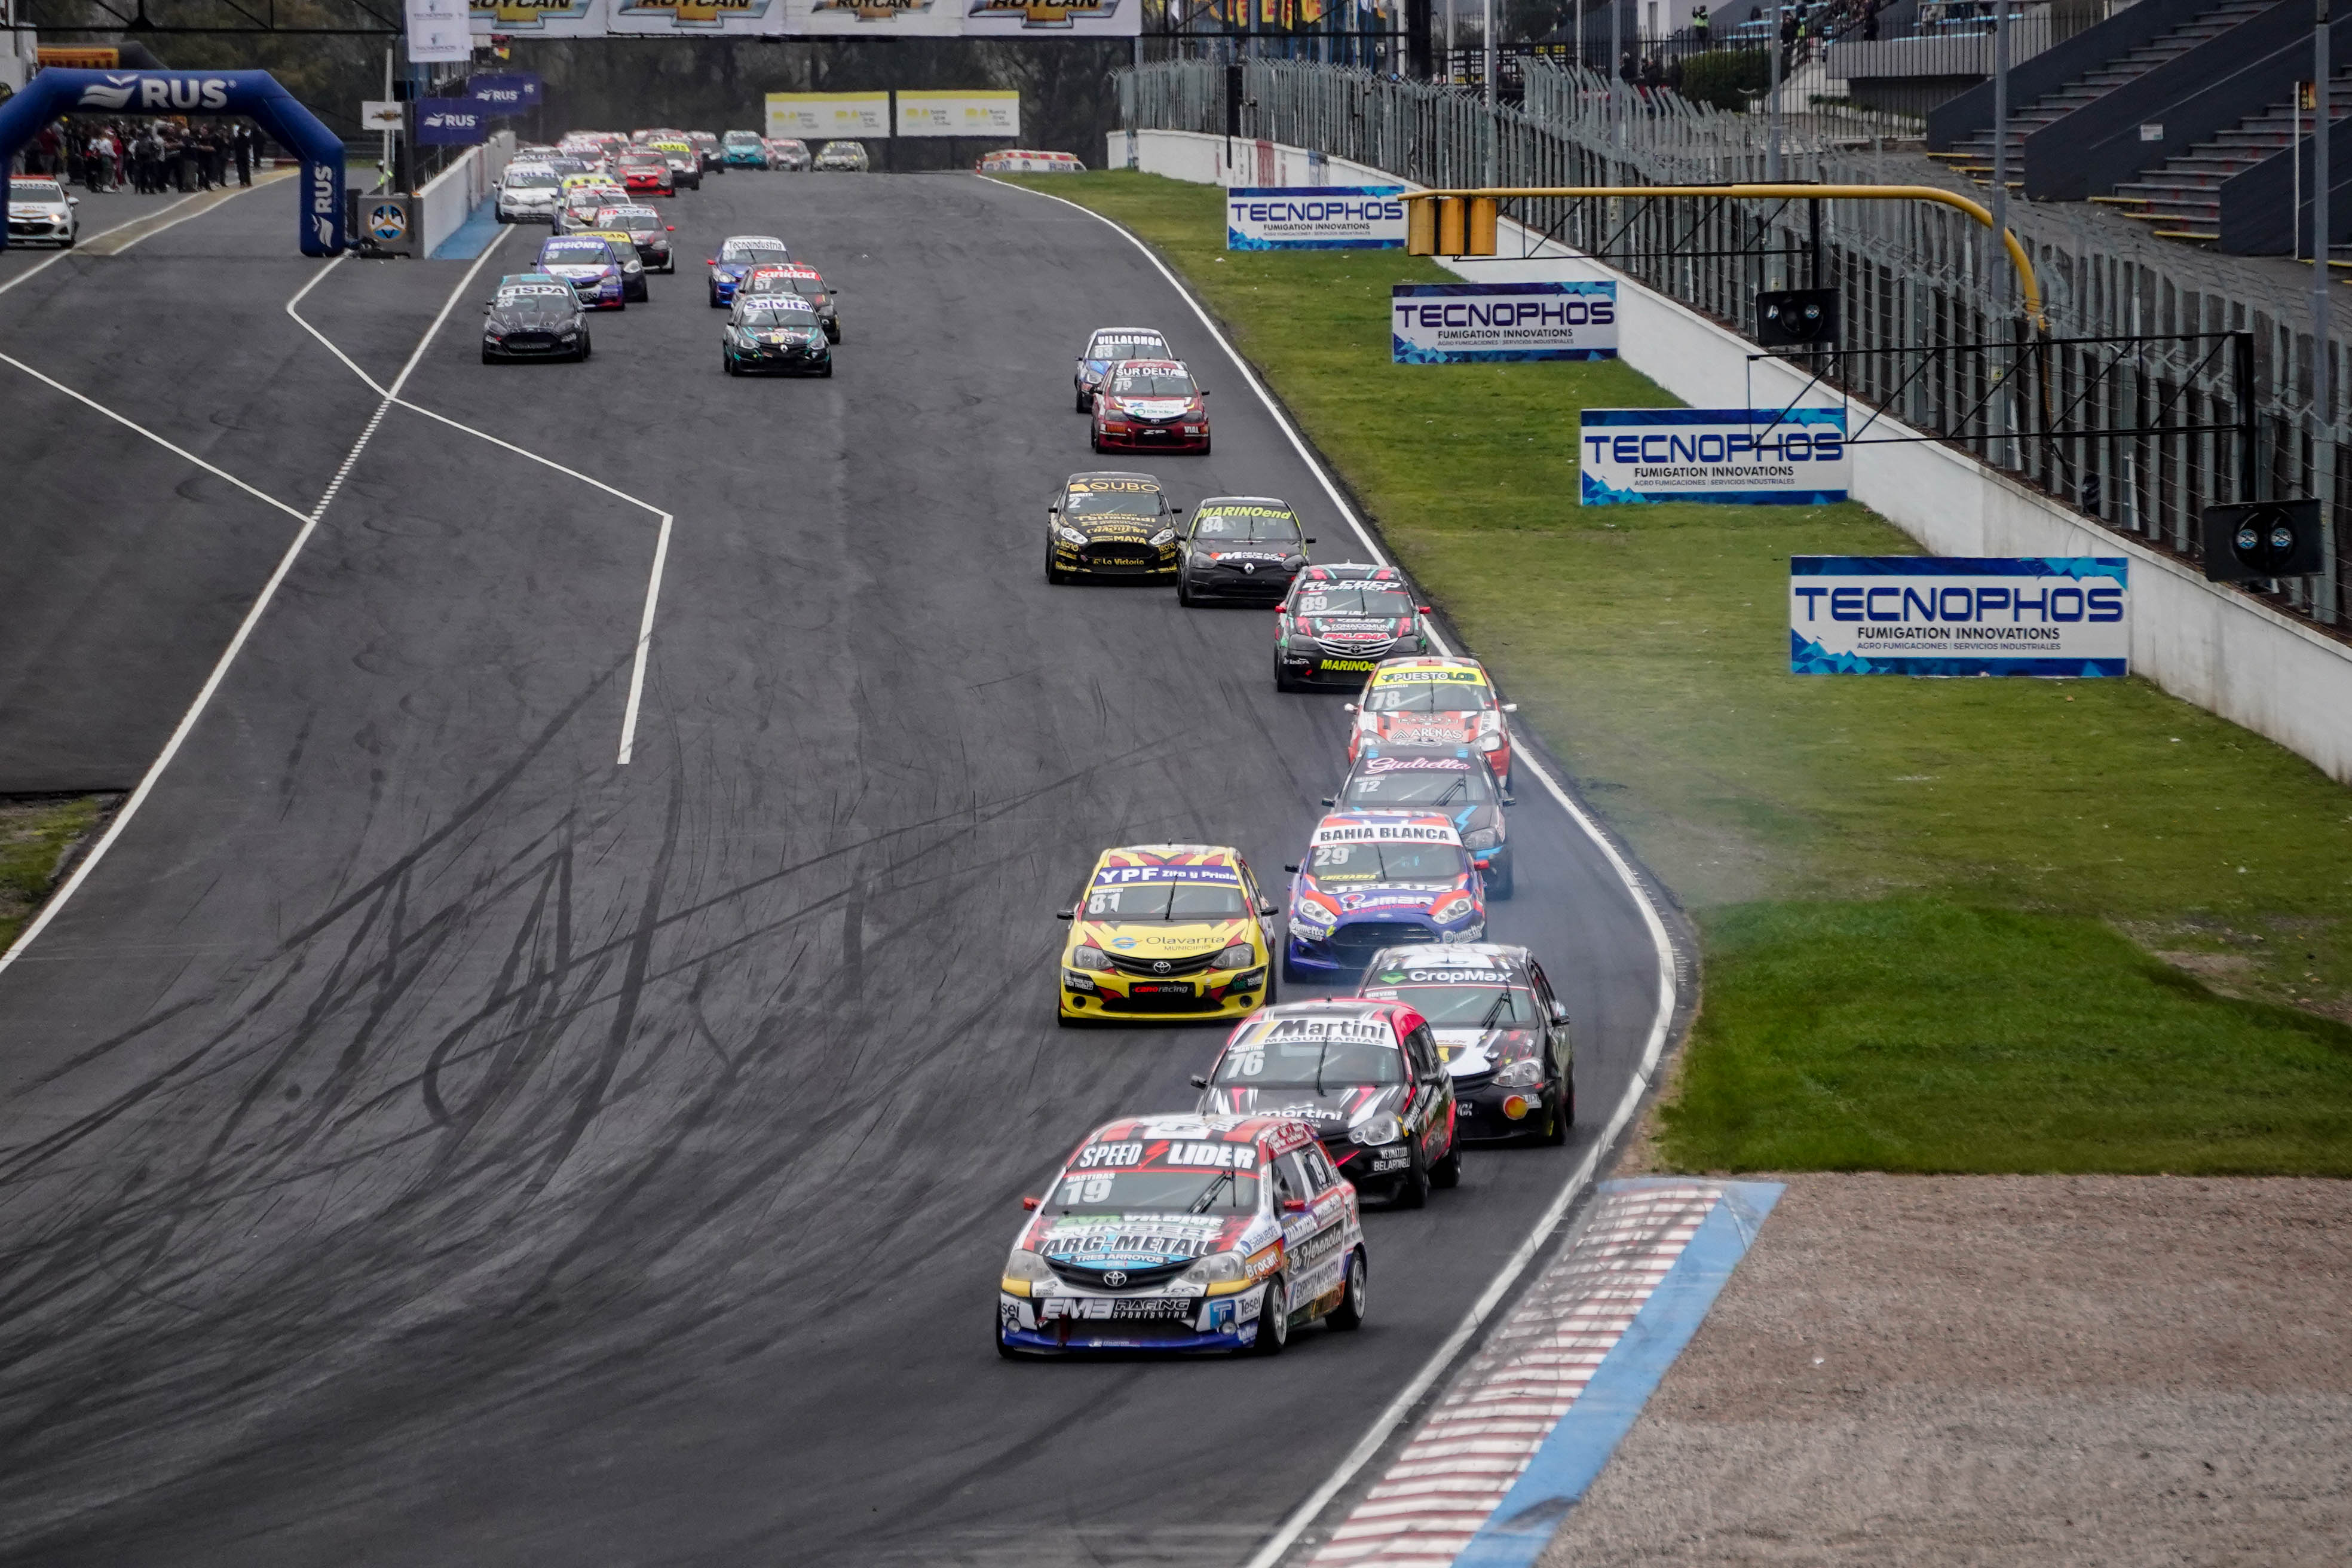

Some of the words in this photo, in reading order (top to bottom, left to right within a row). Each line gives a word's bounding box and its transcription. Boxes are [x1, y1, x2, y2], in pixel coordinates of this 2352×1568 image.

[142, 79, 228, 109] RUS
[492, 90, 518, 100] RUS
[445, 114, 476, 127] RUS
[315, 165, 333, 213] RUS
[1230, 201, 1403, 222] TECNOPHOS
[728, 240, 783, 251] Tecnoindustria
[755, 270, 816, 280] Sanidad
[501, 287, 565, 295] FISPA
[746, 301, 811, 311] Salvita
[1395, 301, 1615, 327] TECNOPHOS
[1437, 330, 1501, 339] FUMIGATION
[1503, 328, 1573, 337] INNOVATIONS
[1116, 368, 1141, 376] SUR
[1143, 368, 1177, 377] DELTA
[1584, 432, 1844, 464] TECNOPHOS
[1634, 467, 1708, 477] FUMIGATION
[1712, 466, 1794, 477] INNOVATIONS
[1089, 482, 1160, 492] QUBO
[1068, 497, 1081, 509] 2
[1199, 506, 1292, 519] MARINOend
[1202, 519, 1224, 533] 84
[1113, 535, 1147, 545] MAYA
[1299, 596, 1328, 611] 89
[1794, 587, 2124, 622] TECNOPHOS
[1322, 632, 1389, 641] PALOMA
[1857, 627, 1951, 640] FUMIGATION
[1956, 627, 2060, 640] INNOVATIONS
[1371, 691, 1401, 710] 78
[1410, 728, 1463, 739] ARENAS
[1358, 781, 1381, 794] 12
[1320, 828, 1374, 842] BAHIA
[1379, 827, 1450, 841] BLANCA
[1315, 847, 1350, 867] 29
[1098, 867, 1159, 884] YPF
[1201, 871, 1238, 880] Priola
[1088, 893, 1122, 914] 81
[1410, 970, 1514, 983] CropMax
[1267, 1019, 1387, 1040] Martini
[1264, 1036, 1384, 1045] MAQUINARIAS
[1227, 1051, 1266, 1079] 76
[1079, 1143, 1144, 1168] SPEED
[1167, 1143, 1256, 1169] LIDER
[1067, 1172, 1116, 1183] BASTIDAS
[1061, 1180, 1113, 1206] 19
[1040, 1235, 1211, 1257] ARG-METAL
[1105, 1254, 1165, 1264] ARROYOS
[1245, 1251, 1279, 1279] Brocart
[1114, 1298, 1191, 1311] RACING
[1238, 1291, 1261, 1315] Tesei
